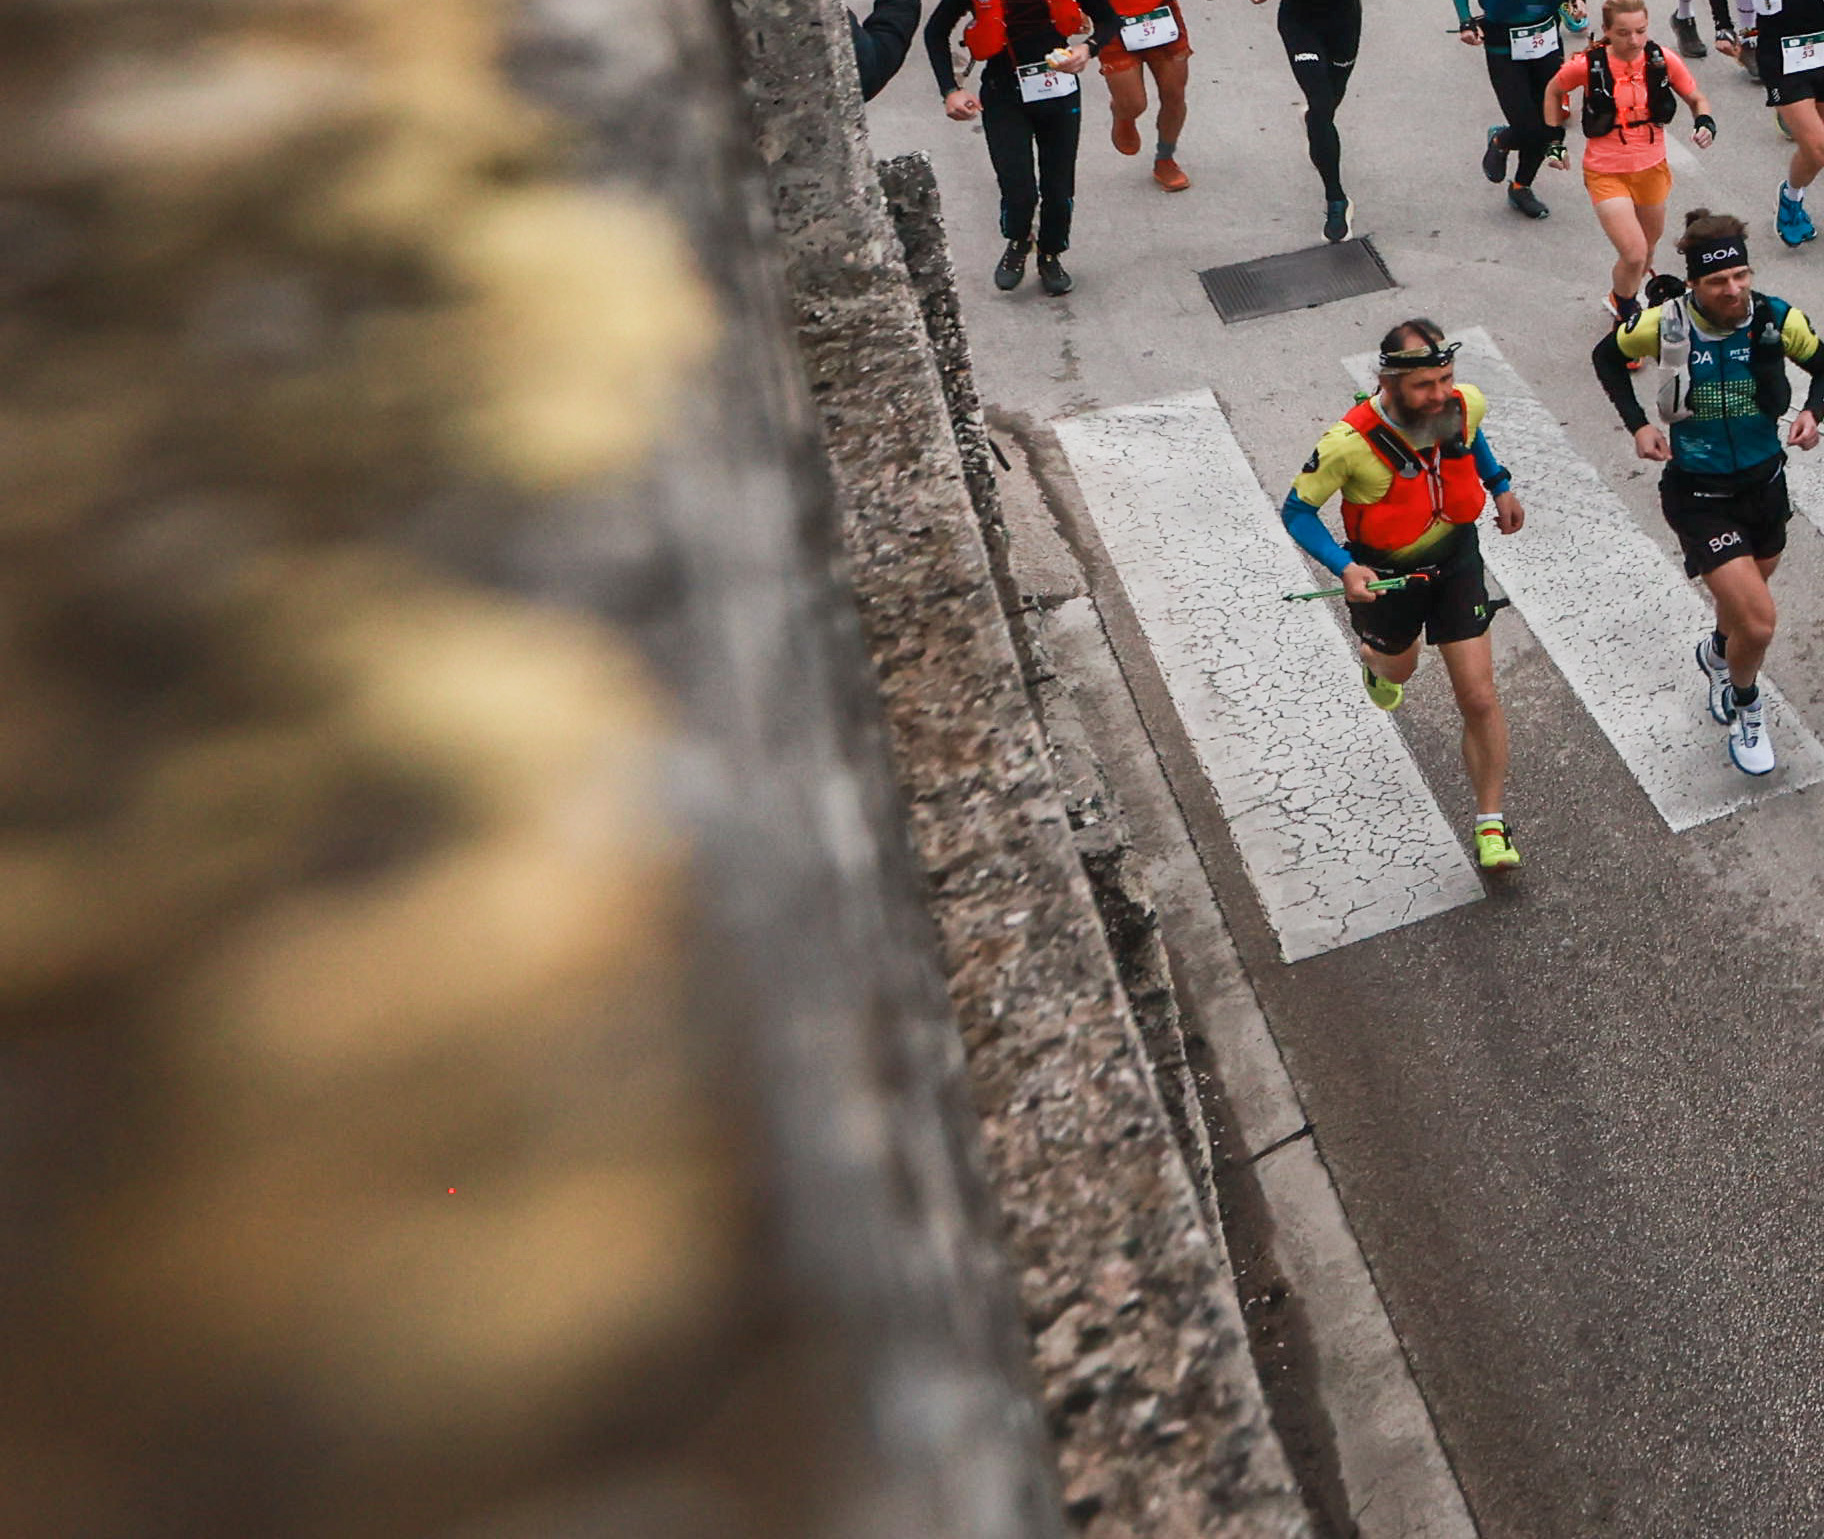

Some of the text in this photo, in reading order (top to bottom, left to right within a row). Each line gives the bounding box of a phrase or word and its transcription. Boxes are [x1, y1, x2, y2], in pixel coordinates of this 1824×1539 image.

[1143, 26, 1156, 36] 57
[1532, 39, 1545, 49] 29
[1044, 77, 1059, 87] 61
[1702, 246, 1739, 264] BOA
[1691, 350, 1714, 365] OA
[1708, 531, 1742, 553] BOA
